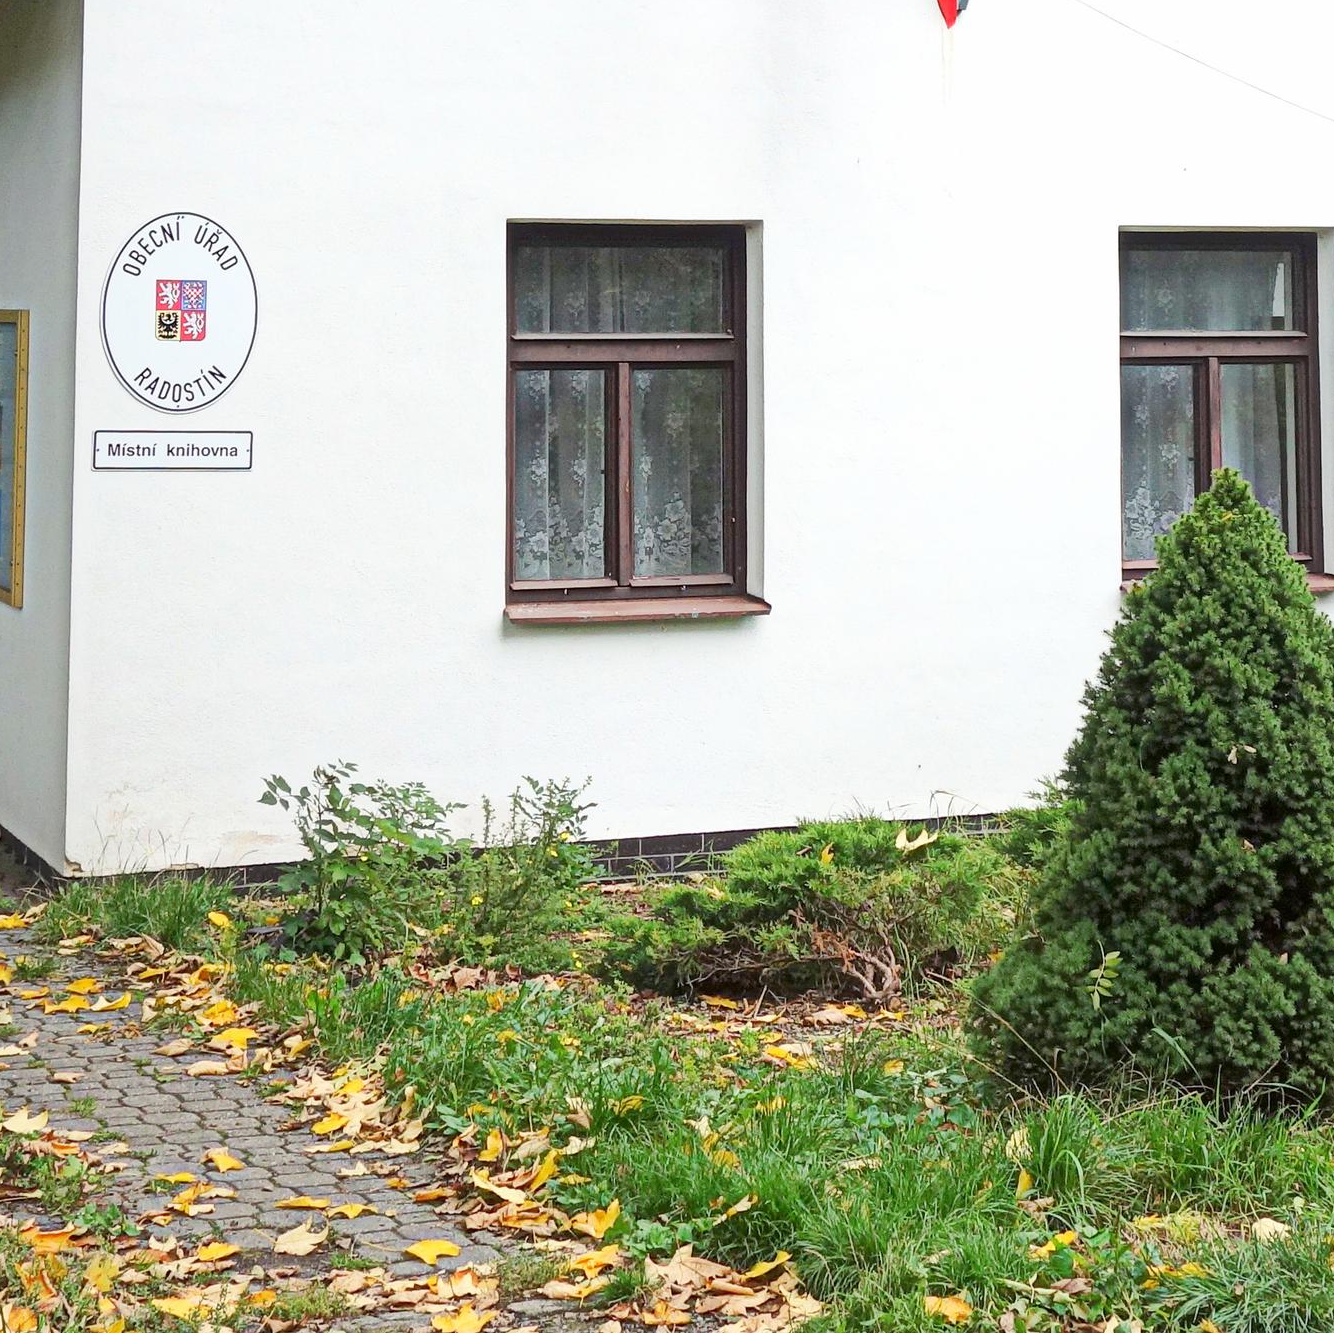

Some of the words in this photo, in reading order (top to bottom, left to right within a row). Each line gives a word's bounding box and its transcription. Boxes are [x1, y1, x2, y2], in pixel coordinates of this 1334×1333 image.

[122, 215, 182, 277] OBECNÍ
[193, 221, 239, 271] ÚŘAD
[133, 365, 228, 404] RADOSTÍN
[107, 442, 158, 457] Místní
[166, 443, 238, 457] knihovna
